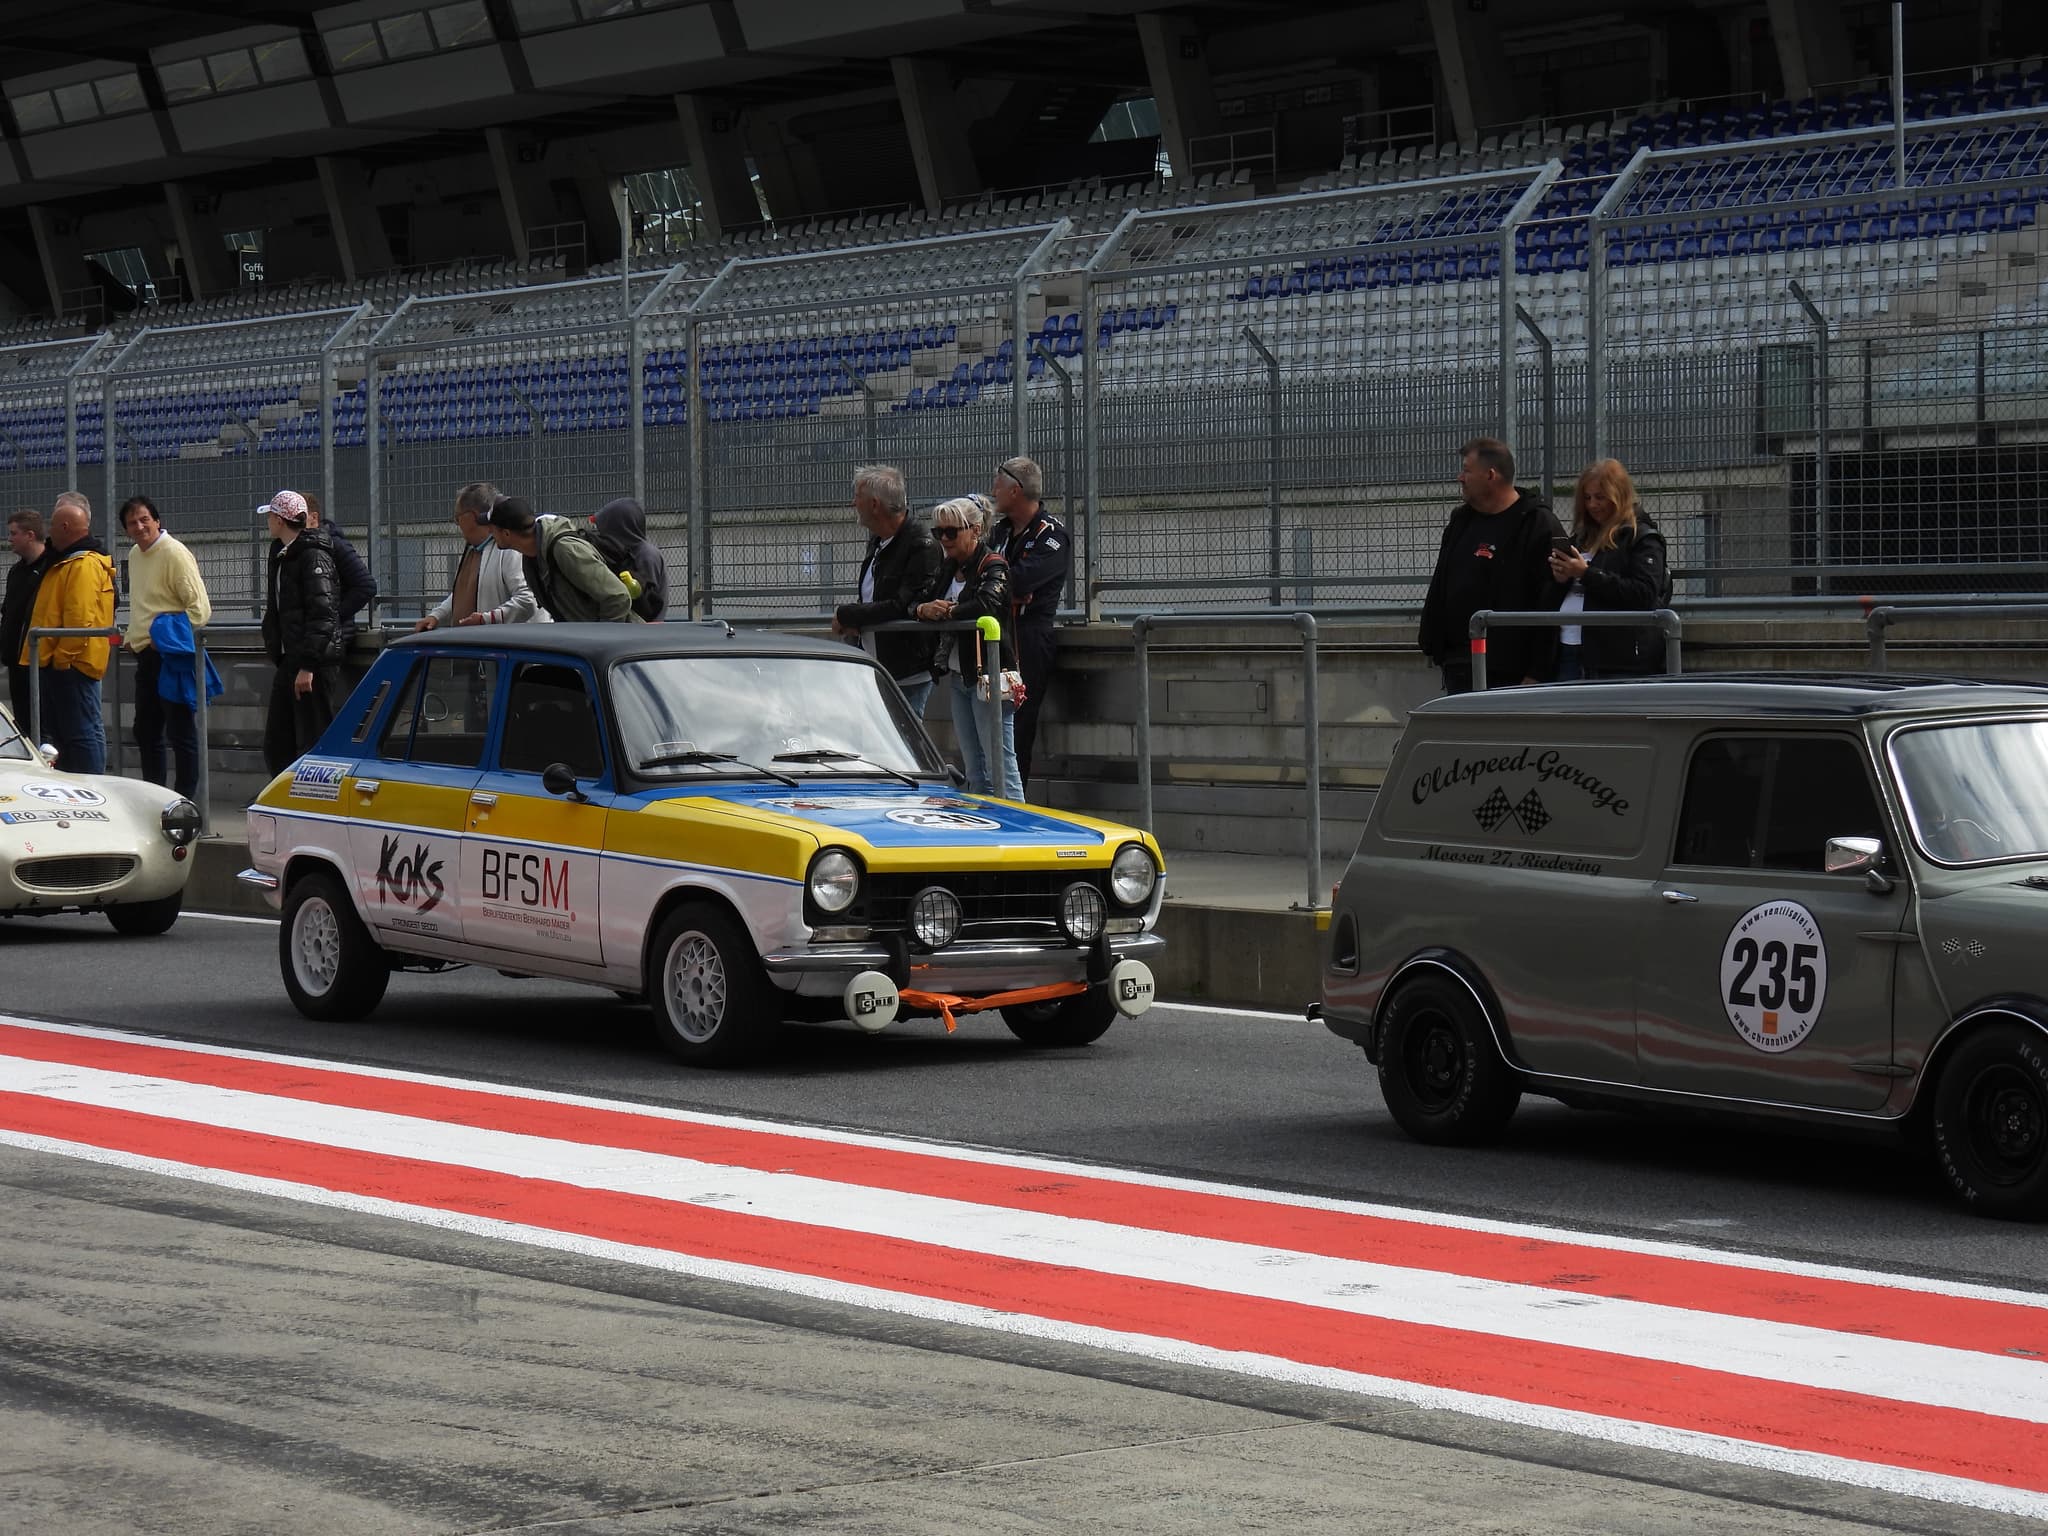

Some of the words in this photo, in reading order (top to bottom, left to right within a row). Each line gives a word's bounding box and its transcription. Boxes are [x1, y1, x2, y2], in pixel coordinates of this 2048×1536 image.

[295, 765, 337, 784] HEINZ
[1412, 747, 1629, 816] Oldspeed-Garage
[30, 787, 98, 801] 210
[48, 811, 70, 819] JS
[1420, 845, 1484, 864] Moosen
[1490, 850, 1513, 867] 27,
[1517, 854, 1602, 876] Riedering
[1740, 905, 1815, 940] www.ventilspiel.at
[1729, 937, 1818, 1014] 235
[1734, 1012, 1809, 1047] www.chronothek.at
